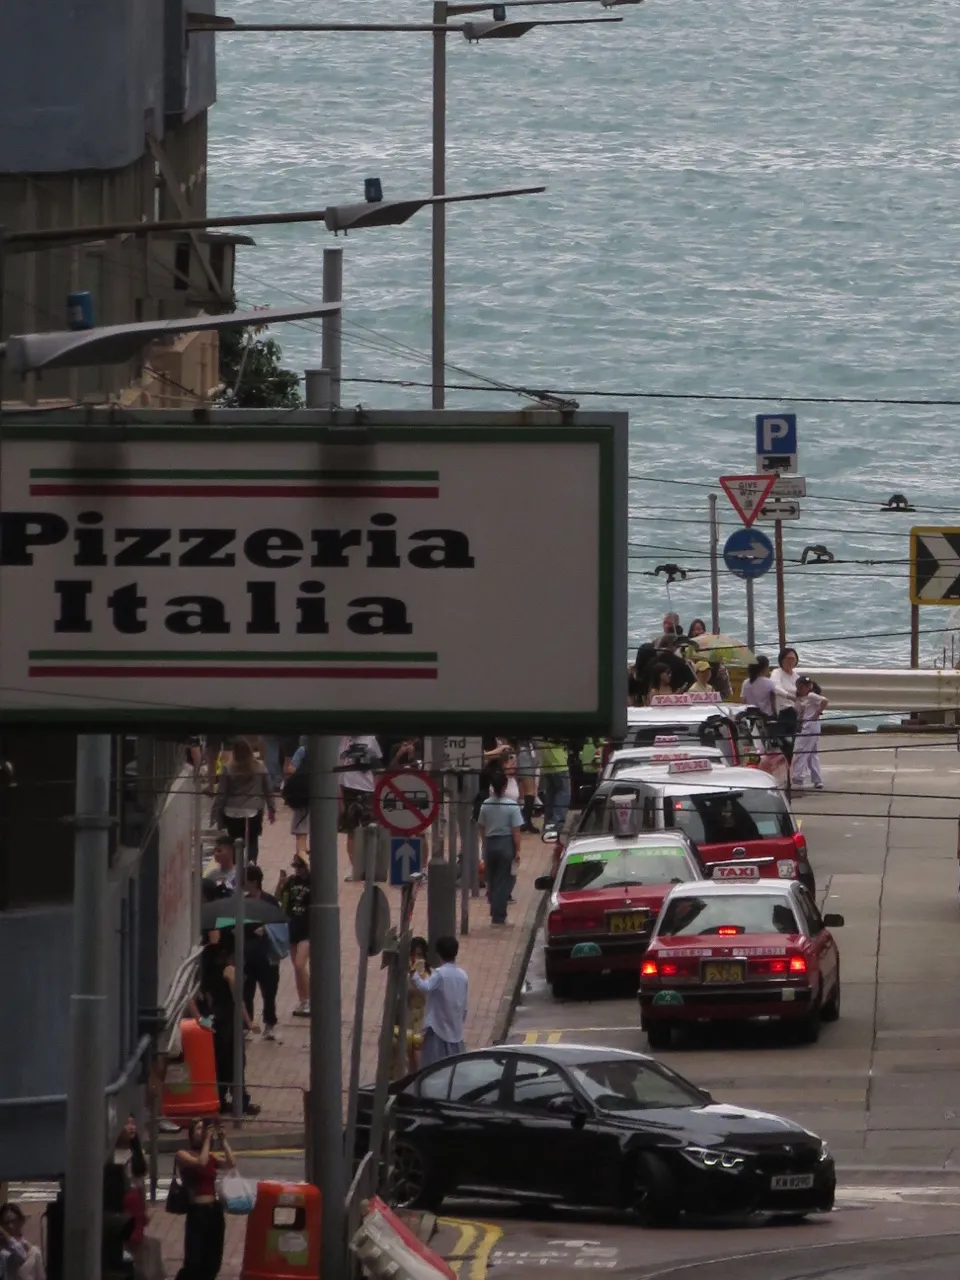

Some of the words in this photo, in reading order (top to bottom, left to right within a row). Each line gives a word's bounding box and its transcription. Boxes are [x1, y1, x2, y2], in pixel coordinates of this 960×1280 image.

[763, 419, 789, 451] P
[0, 511, 475, 569] Pizzeria
[53, 580, 414, 635] Italia
[654, 696, 689, 704] TAXI
[674, 760, 708, 771] TAXI
[718, 867, 755, 877] TAXI
